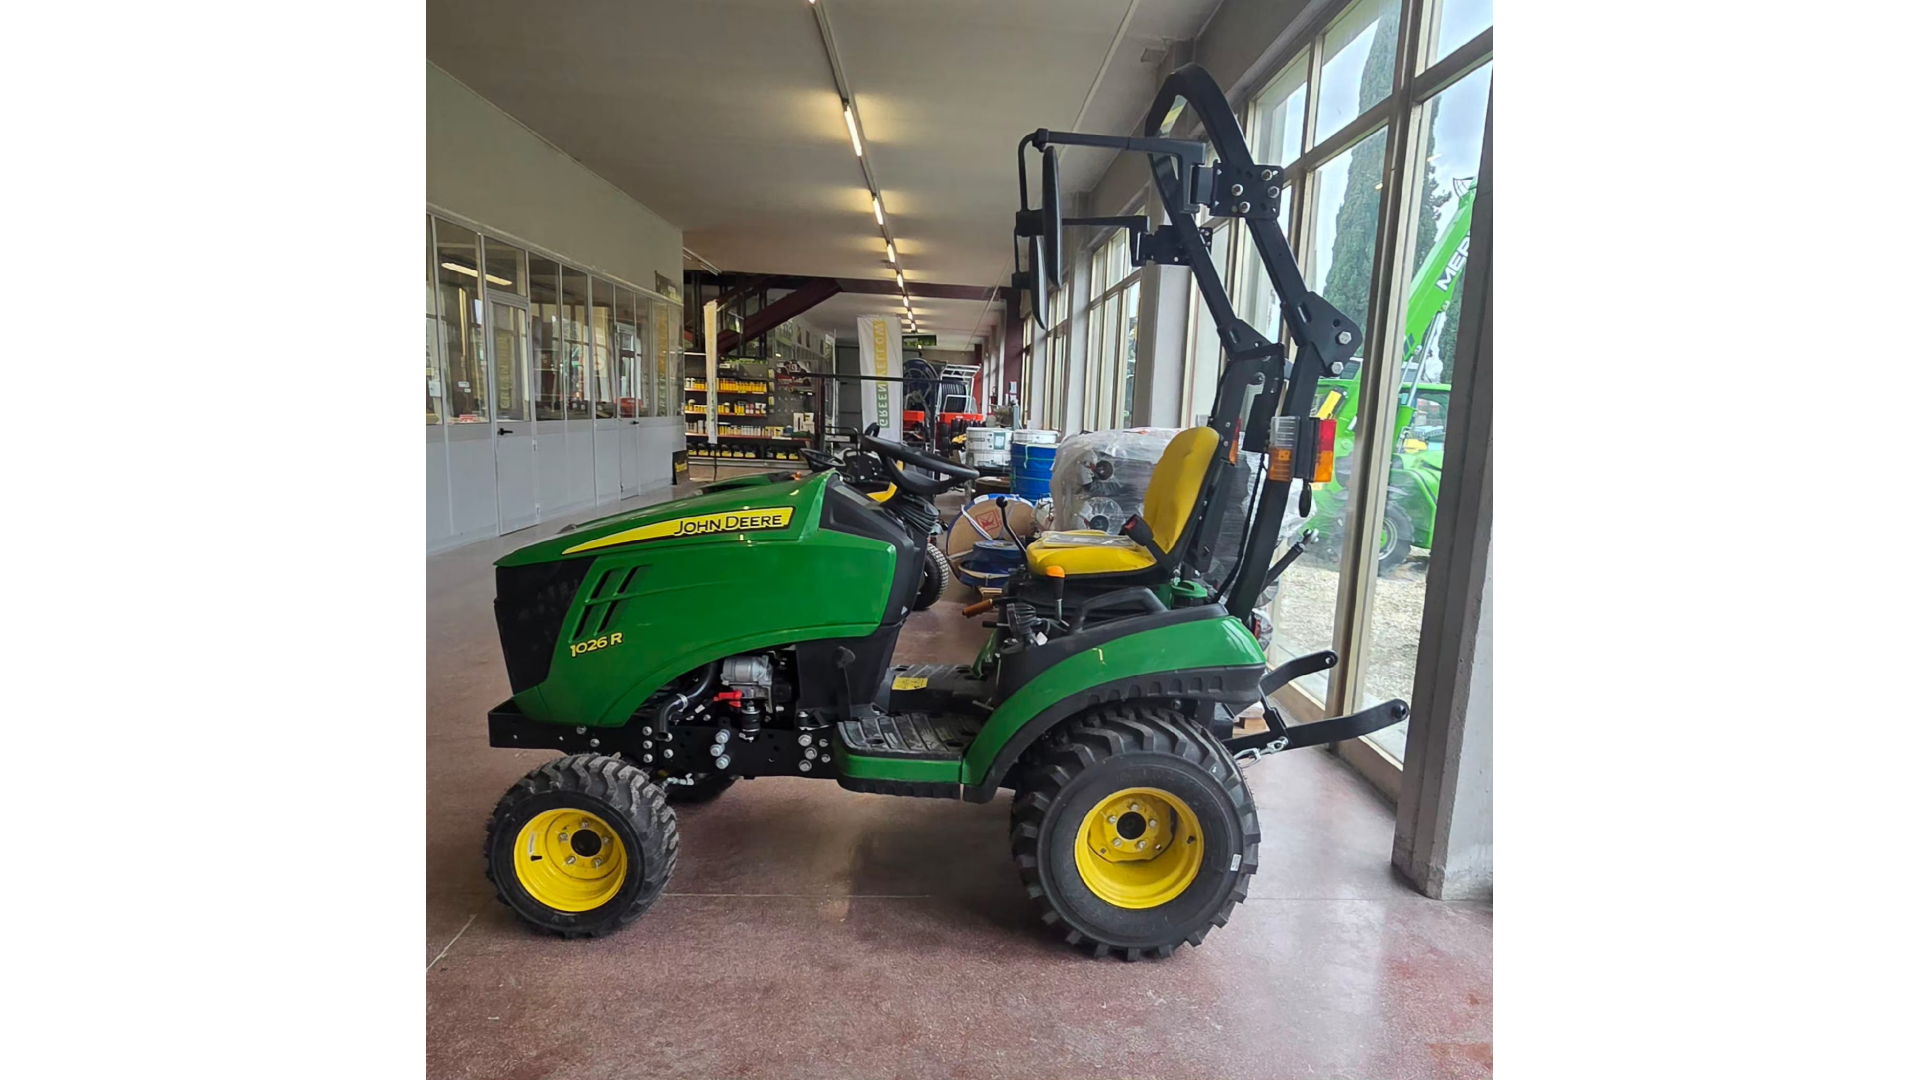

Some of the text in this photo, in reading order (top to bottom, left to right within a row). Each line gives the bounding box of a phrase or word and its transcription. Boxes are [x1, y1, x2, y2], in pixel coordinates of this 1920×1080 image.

[1436, 230, 1470, 291] MER
[673, 515, 782, 535] JOHN DEERE
[569, 632, 623, 657] 1026 R
